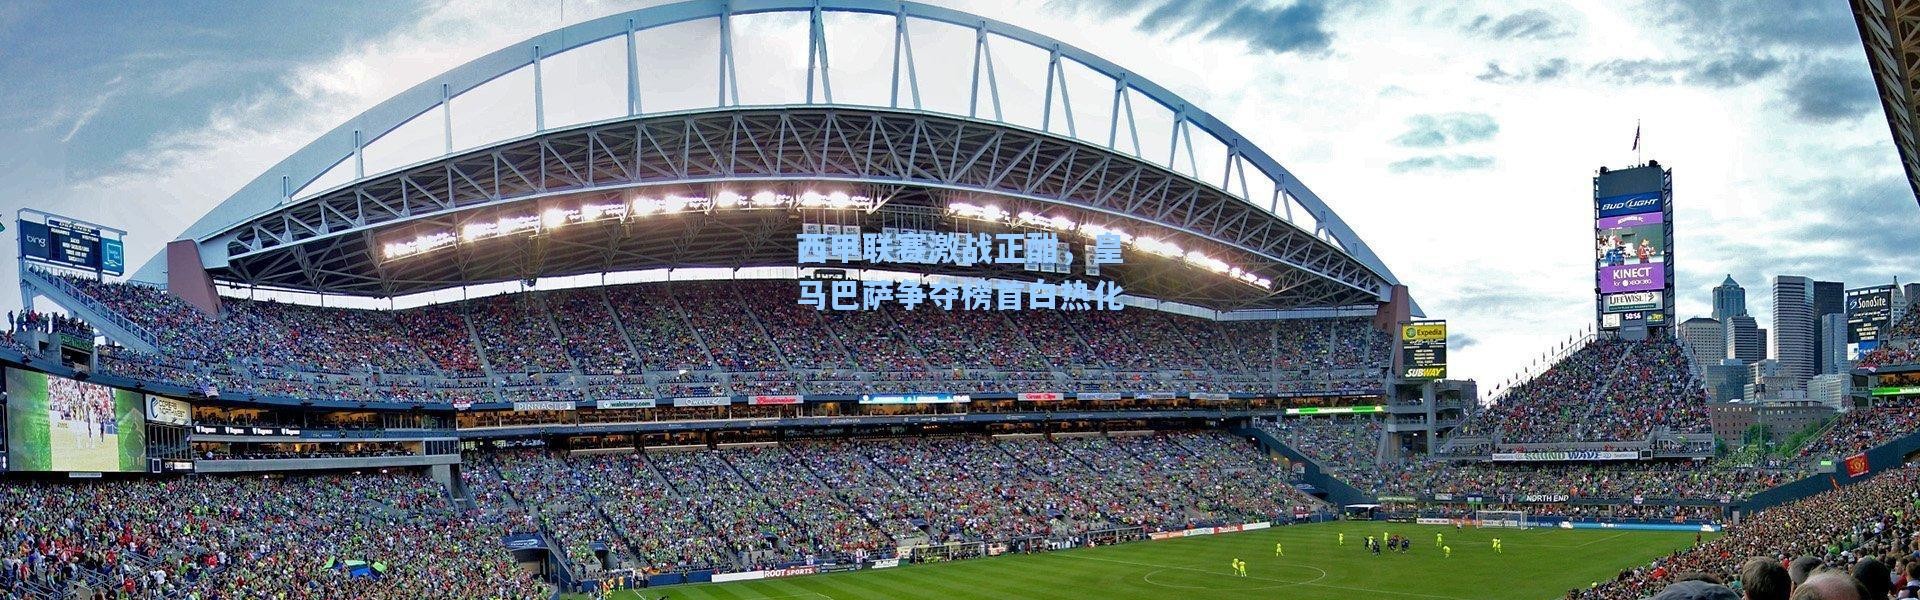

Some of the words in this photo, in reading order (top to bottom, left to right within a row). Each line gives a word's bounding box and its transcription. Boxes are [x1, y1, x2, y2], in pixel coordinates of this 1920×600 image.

[1628, 199, 1658, 207] LIGHT
[26, 234, 46, 248] bing
[1613, 267, 1653, 279] KINECT
[1858, 296, 1886, 308] SonoSite
[1417, 329, 1442, 337] Expedia
[1405, 368, 1445, 377] SUBWAY
[518, 402, 567, 411] PINNACLE
[611, 400, 651, 408] walottery.com
[1568, 451, 1600, 459] WAVE
[764, 569, 786, 578] ROOT
